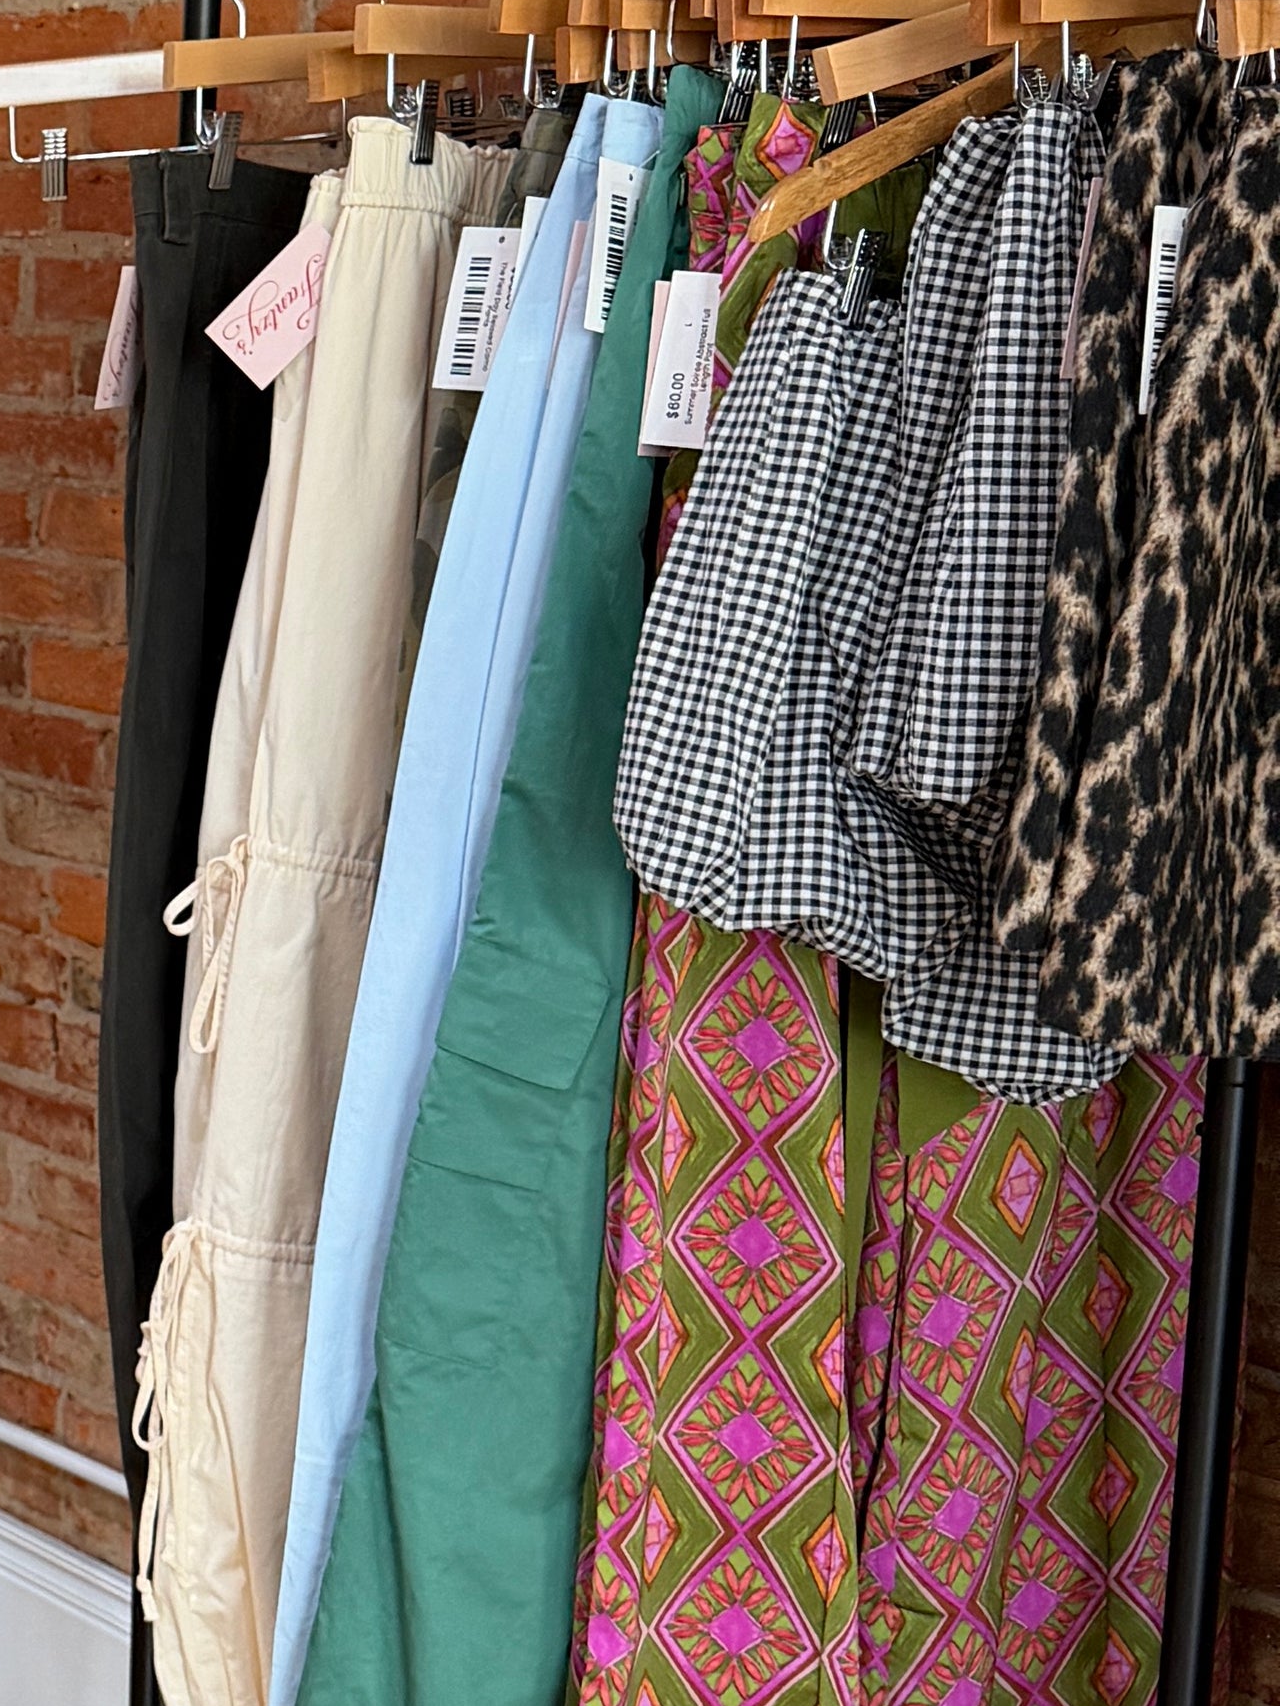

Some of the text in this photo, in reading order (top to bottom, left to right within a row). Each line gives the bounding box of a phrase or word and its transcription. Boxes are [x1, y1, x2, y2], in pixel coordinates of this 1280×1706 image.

[695, 324, 709, 360] Abstract
[702, 308, 711, 323] Full
[699, 362, 711, 392] Length
